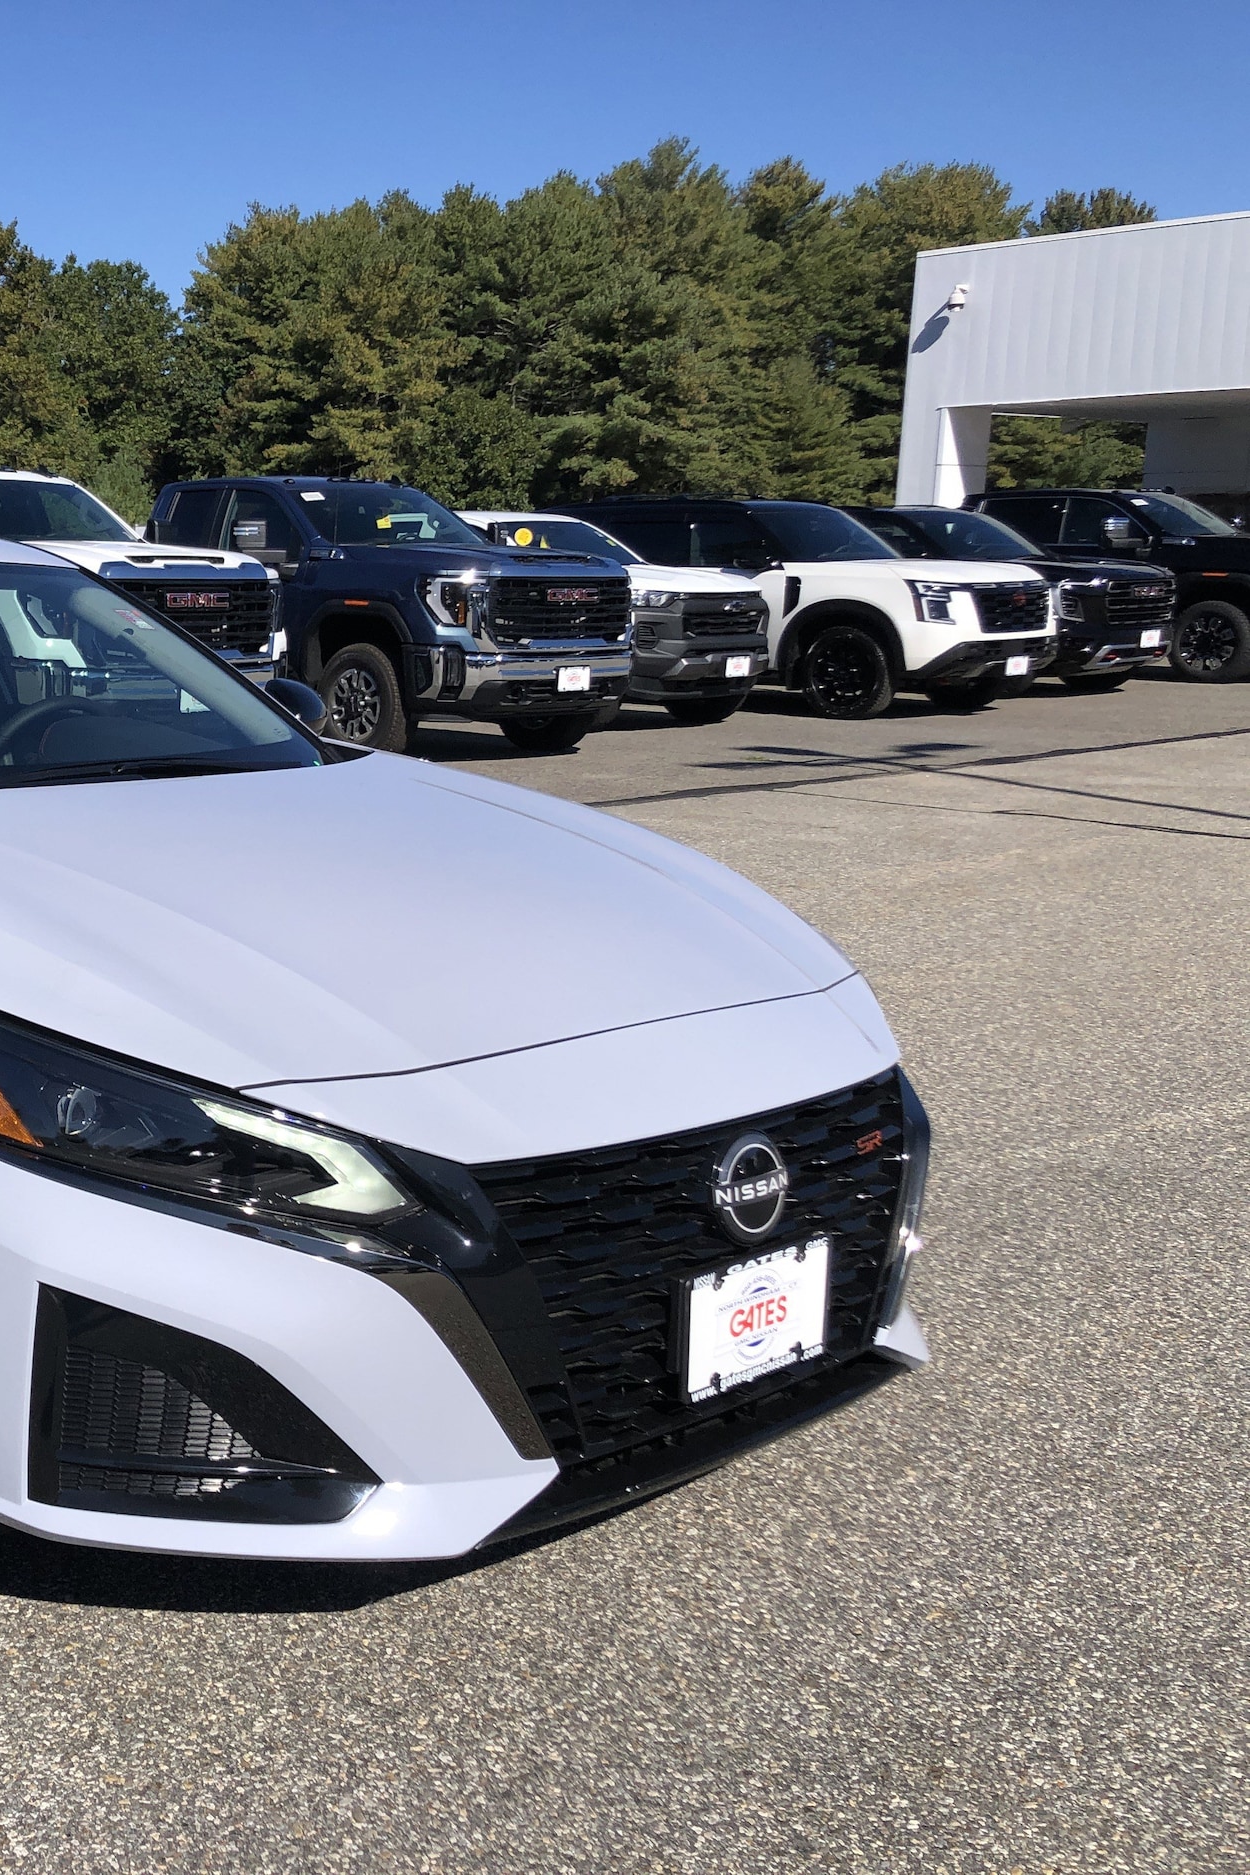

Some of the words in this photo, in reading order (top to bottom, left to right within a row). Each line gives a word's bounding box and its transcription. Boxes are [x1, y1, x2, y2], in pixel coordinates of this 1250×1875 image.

[166, 592, 230, 608] GMC
[547, 587, 599, 602] GMC
[856, 1130, 883, 1155] SR
[715, 1171, 789, 1205] NISSAN
[805, 1237, 829, 1250] GMC
[726, 1246, 798, 1275] GATES
[729, 1295, 787, 1337] GATES
